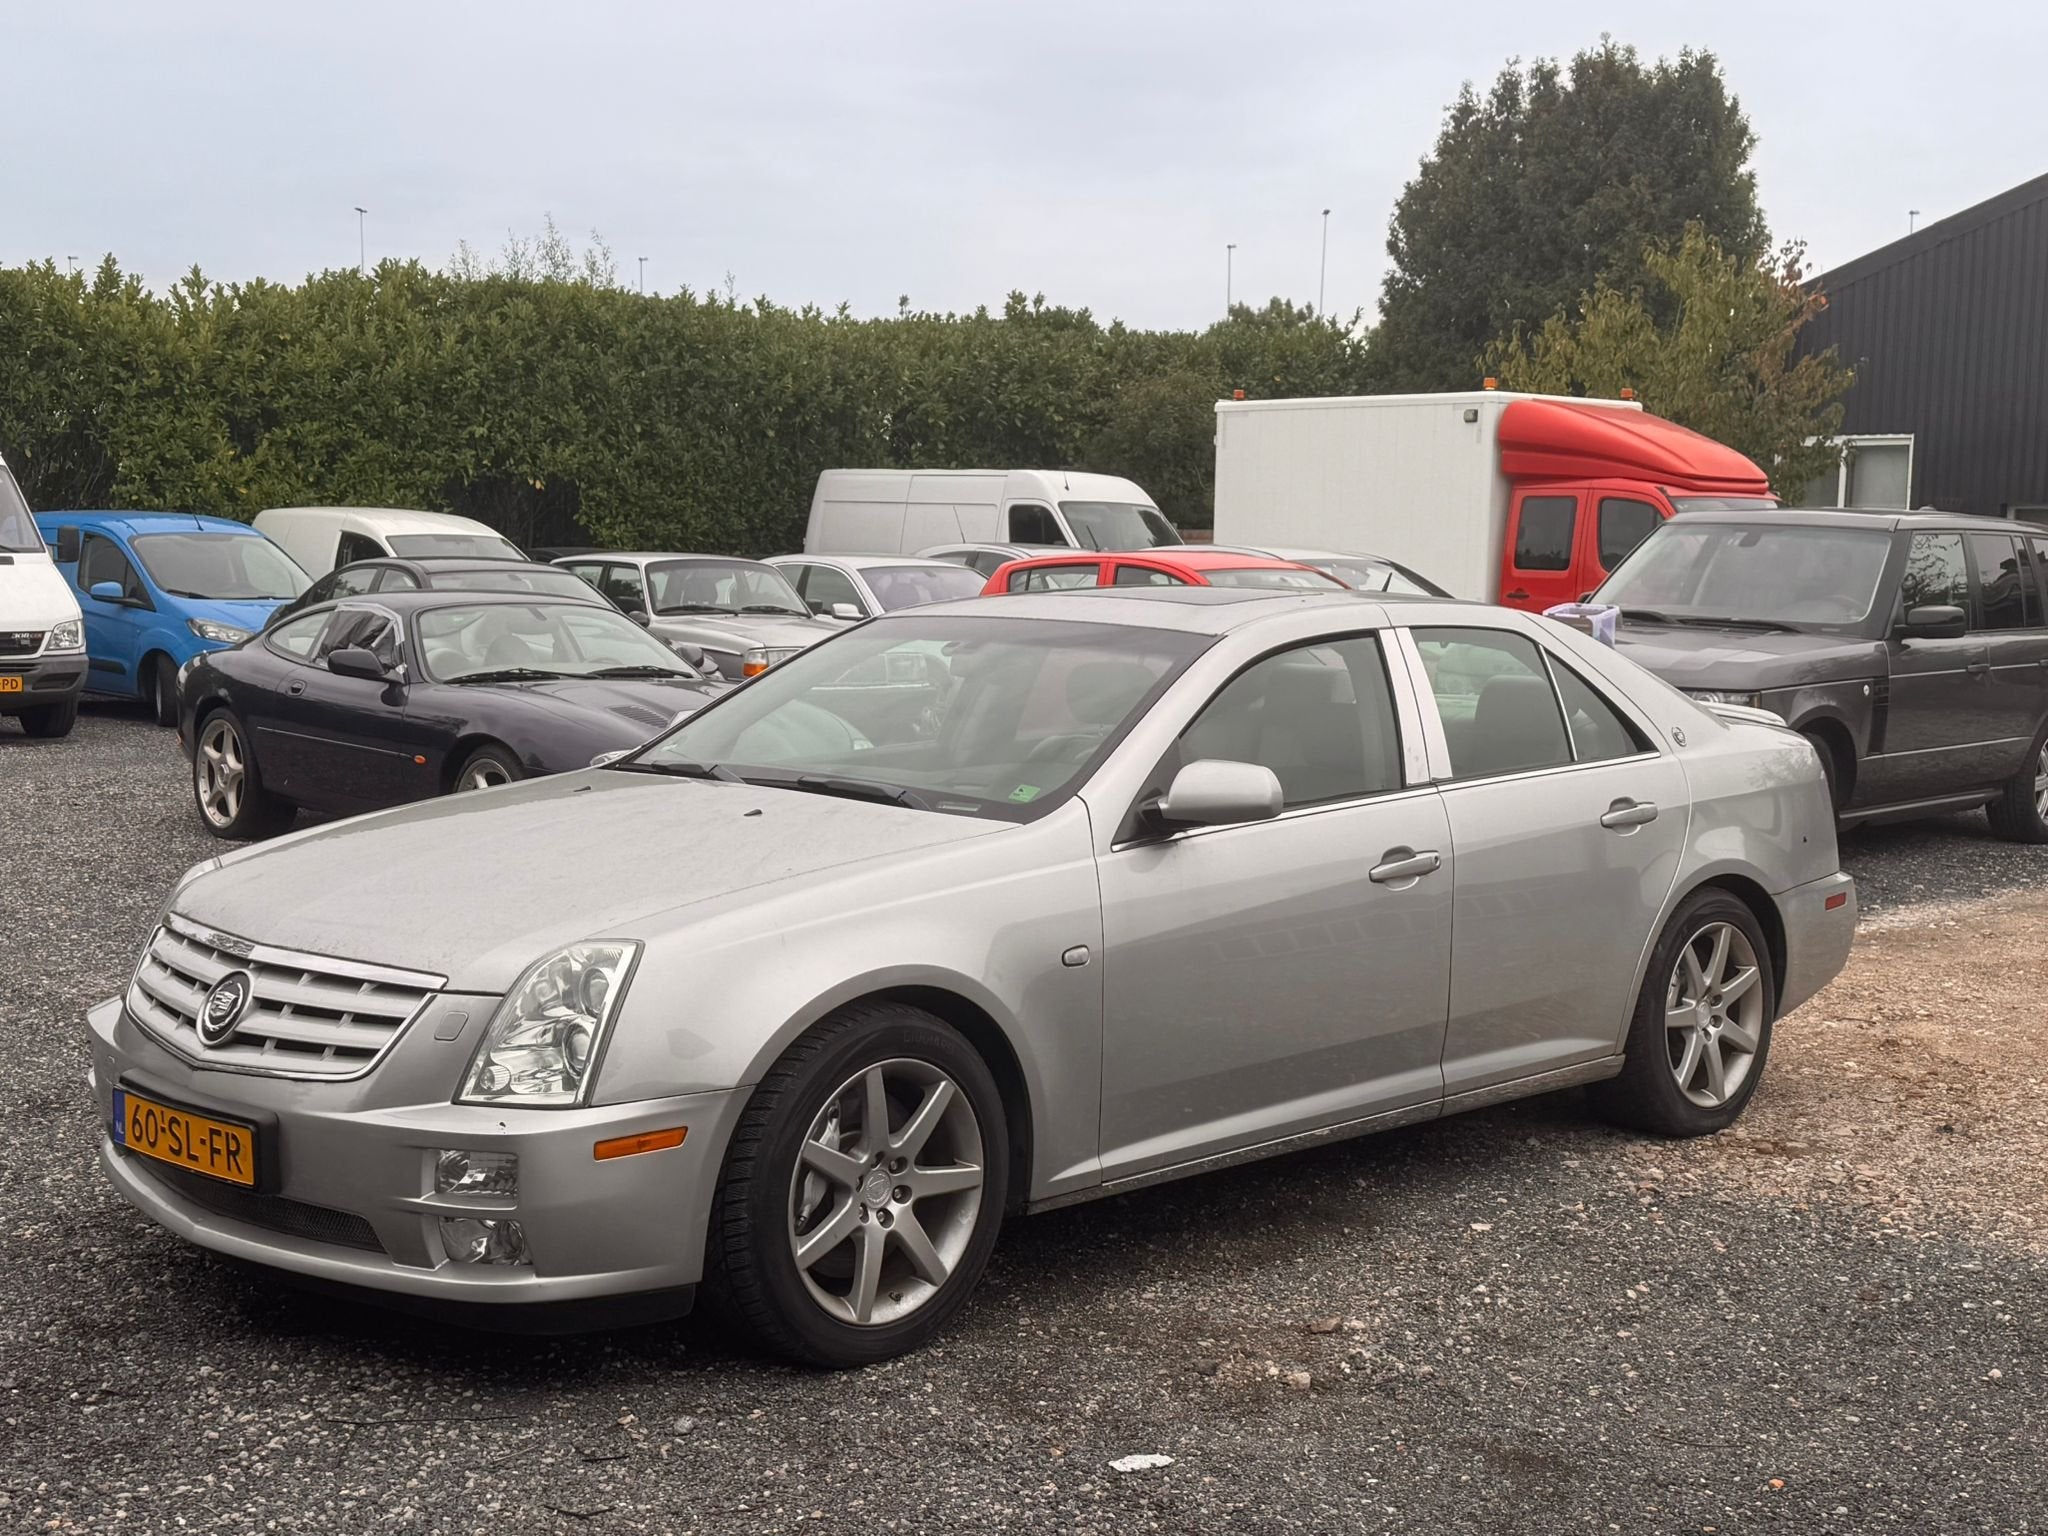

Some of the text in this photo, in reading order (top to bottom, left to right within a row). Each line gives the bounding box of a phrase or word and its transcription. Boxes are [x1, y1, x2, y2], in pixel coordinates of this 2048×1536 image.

[0, 679, 18, 689] PD
[115, 1120, 125, 1135] NL
[131, 1104, 243, 1175] 60-SL-FR
